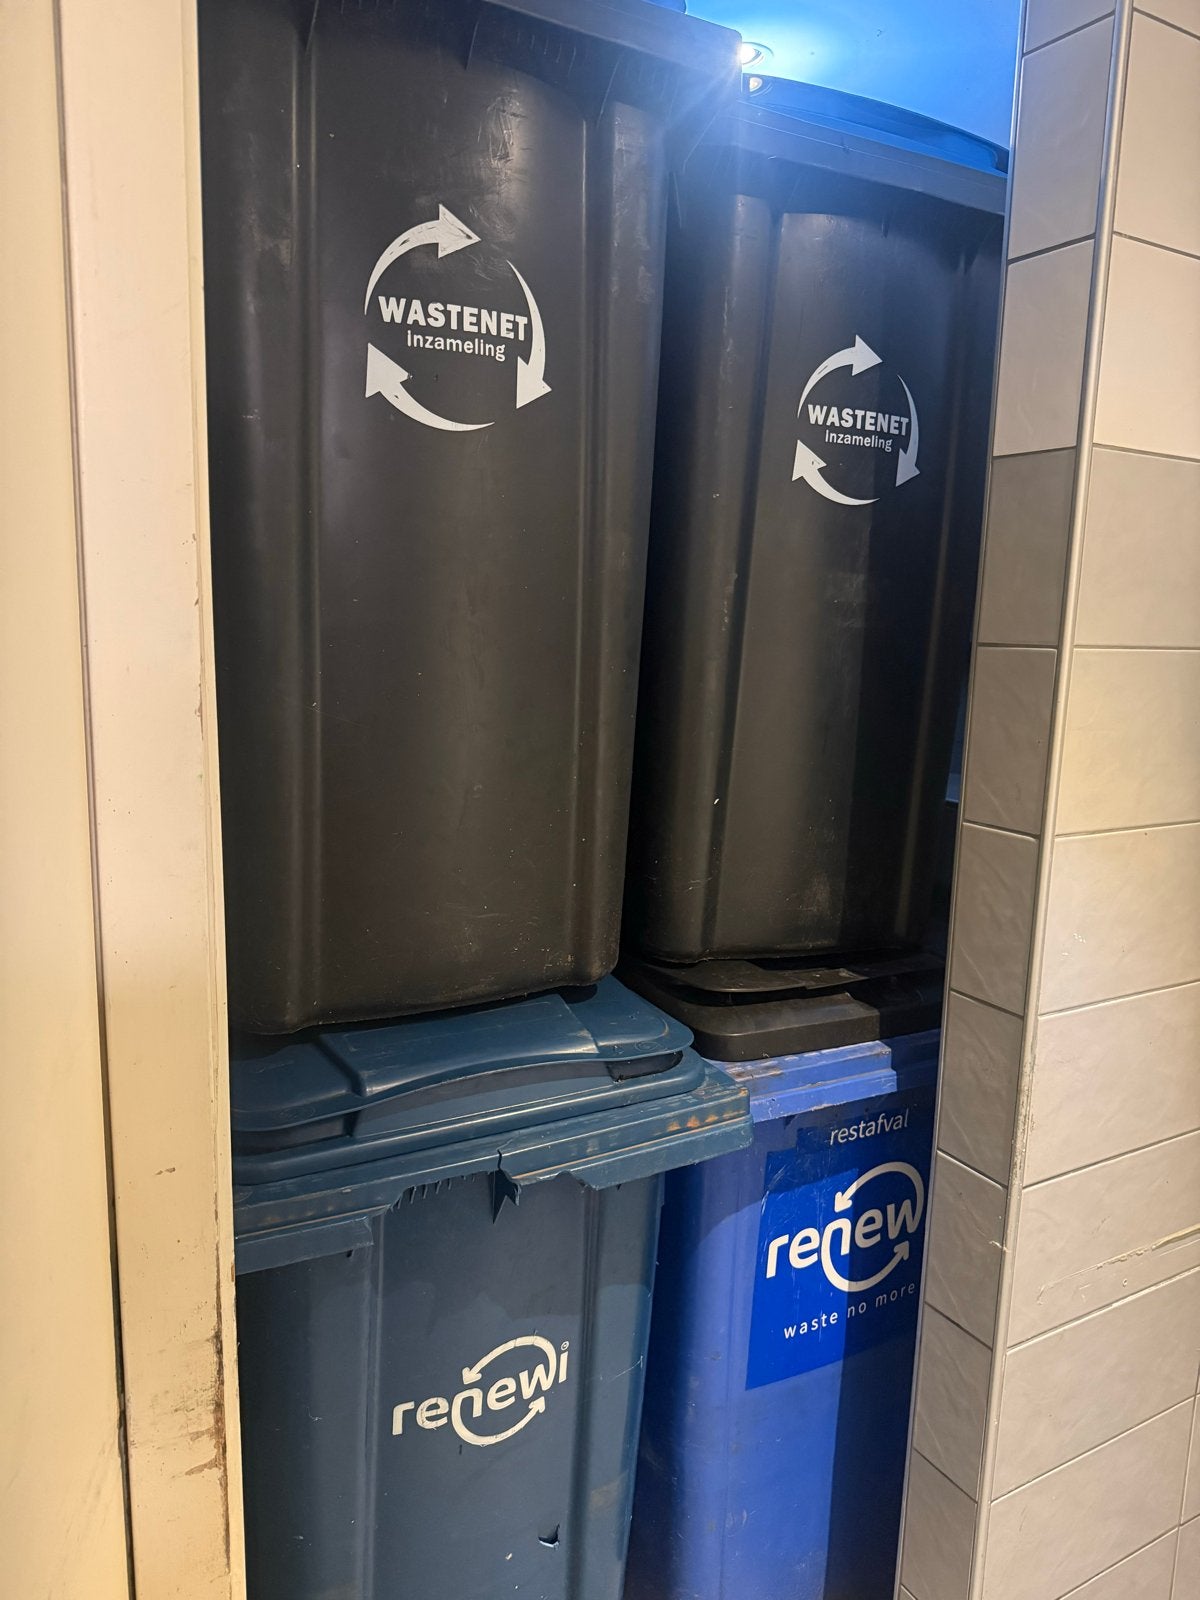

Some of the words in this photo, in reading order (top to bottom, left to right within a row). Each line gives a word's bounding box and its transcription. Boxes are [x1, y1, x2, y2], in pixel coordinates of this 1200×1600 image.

[378, 295, 528, 341] WASTENET
[407, 330, 506, 362] inzameling
[807, 403, 910, 436] WASTENET
[829, 1109, 908, 1146] restafval
[765, 1172, 925, 1292] renew
[784, 1312, 839, 1339] waste
[847, 1302, 867, 1318] no
[875, 1281, 916, 1308] more
[392, 1337, 570, 1446] renewi
